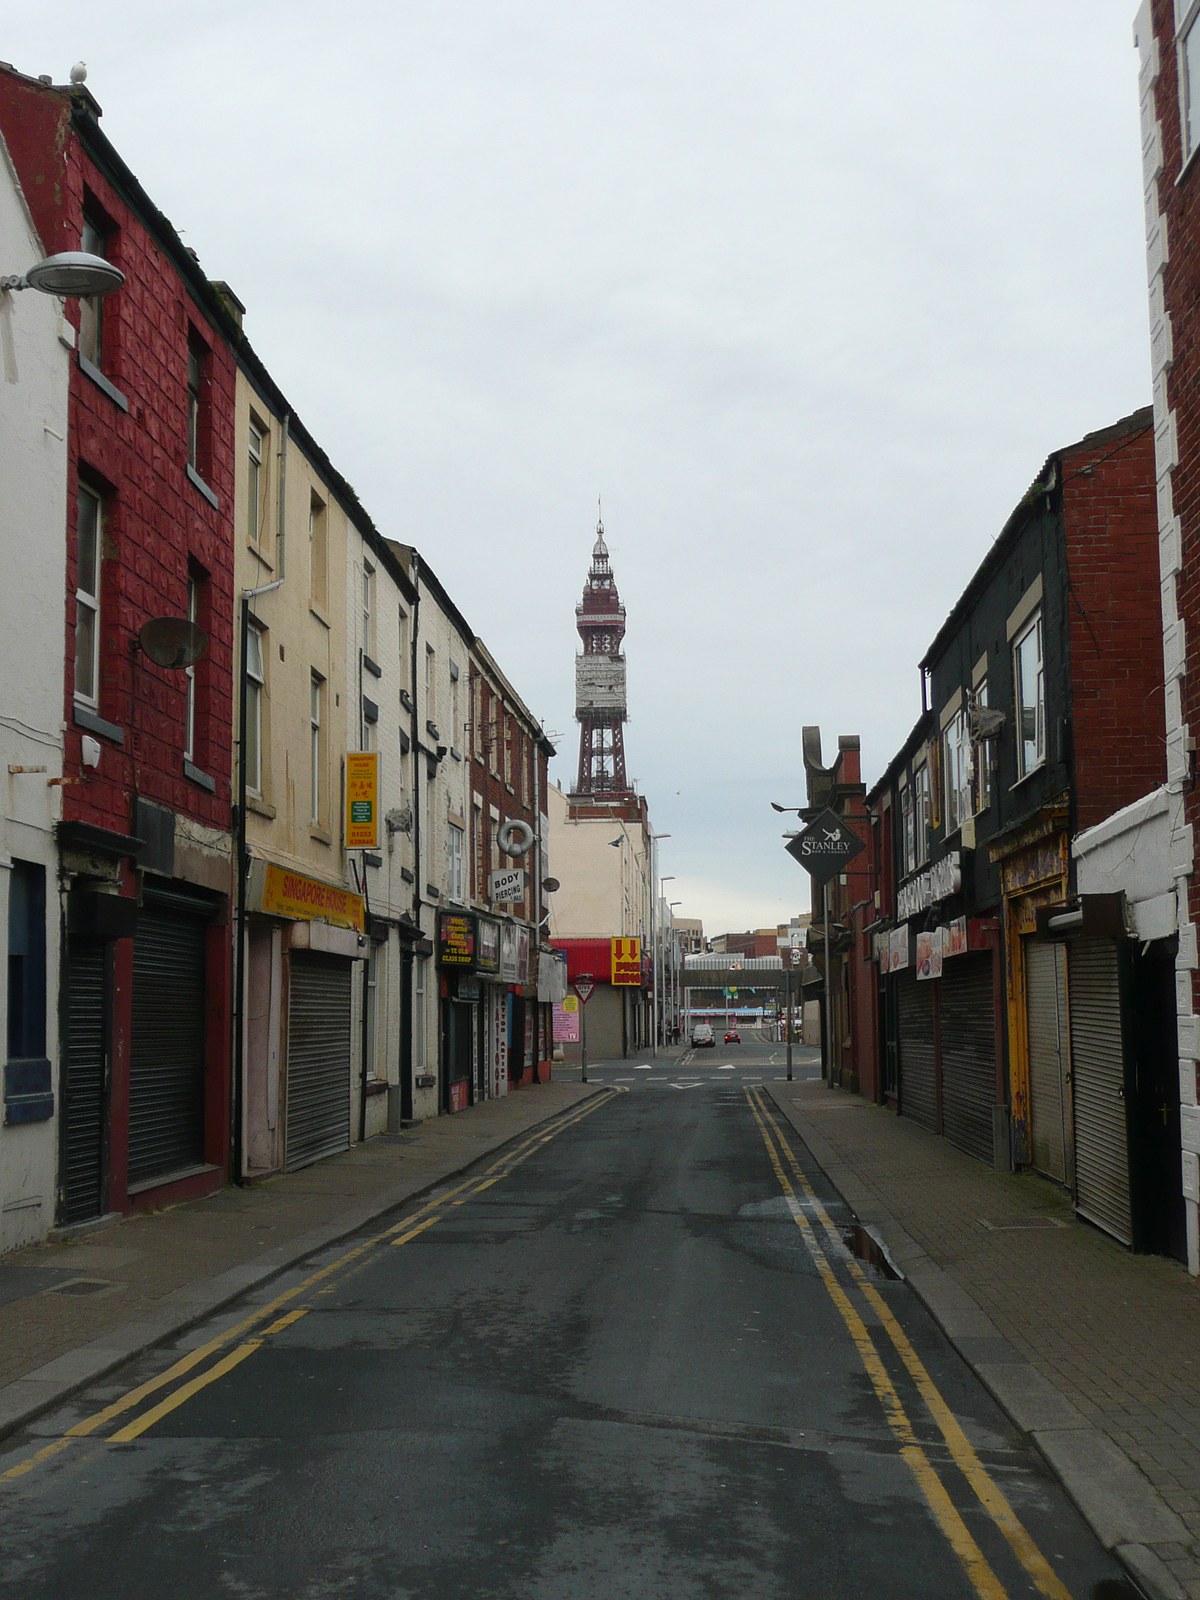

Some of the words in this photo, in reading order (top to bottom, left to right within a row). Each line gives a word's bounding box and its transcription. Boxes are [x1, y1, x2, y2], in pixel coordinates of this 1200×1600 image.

[802, 841, 850, 855] STANLEY
[494, 872, 519, 889] BODY
[283, 875, 325, 907] SINGAPORE
[326, 888, 346, 914] HOUSE
[495, 884, 521, 900] PIERCING
